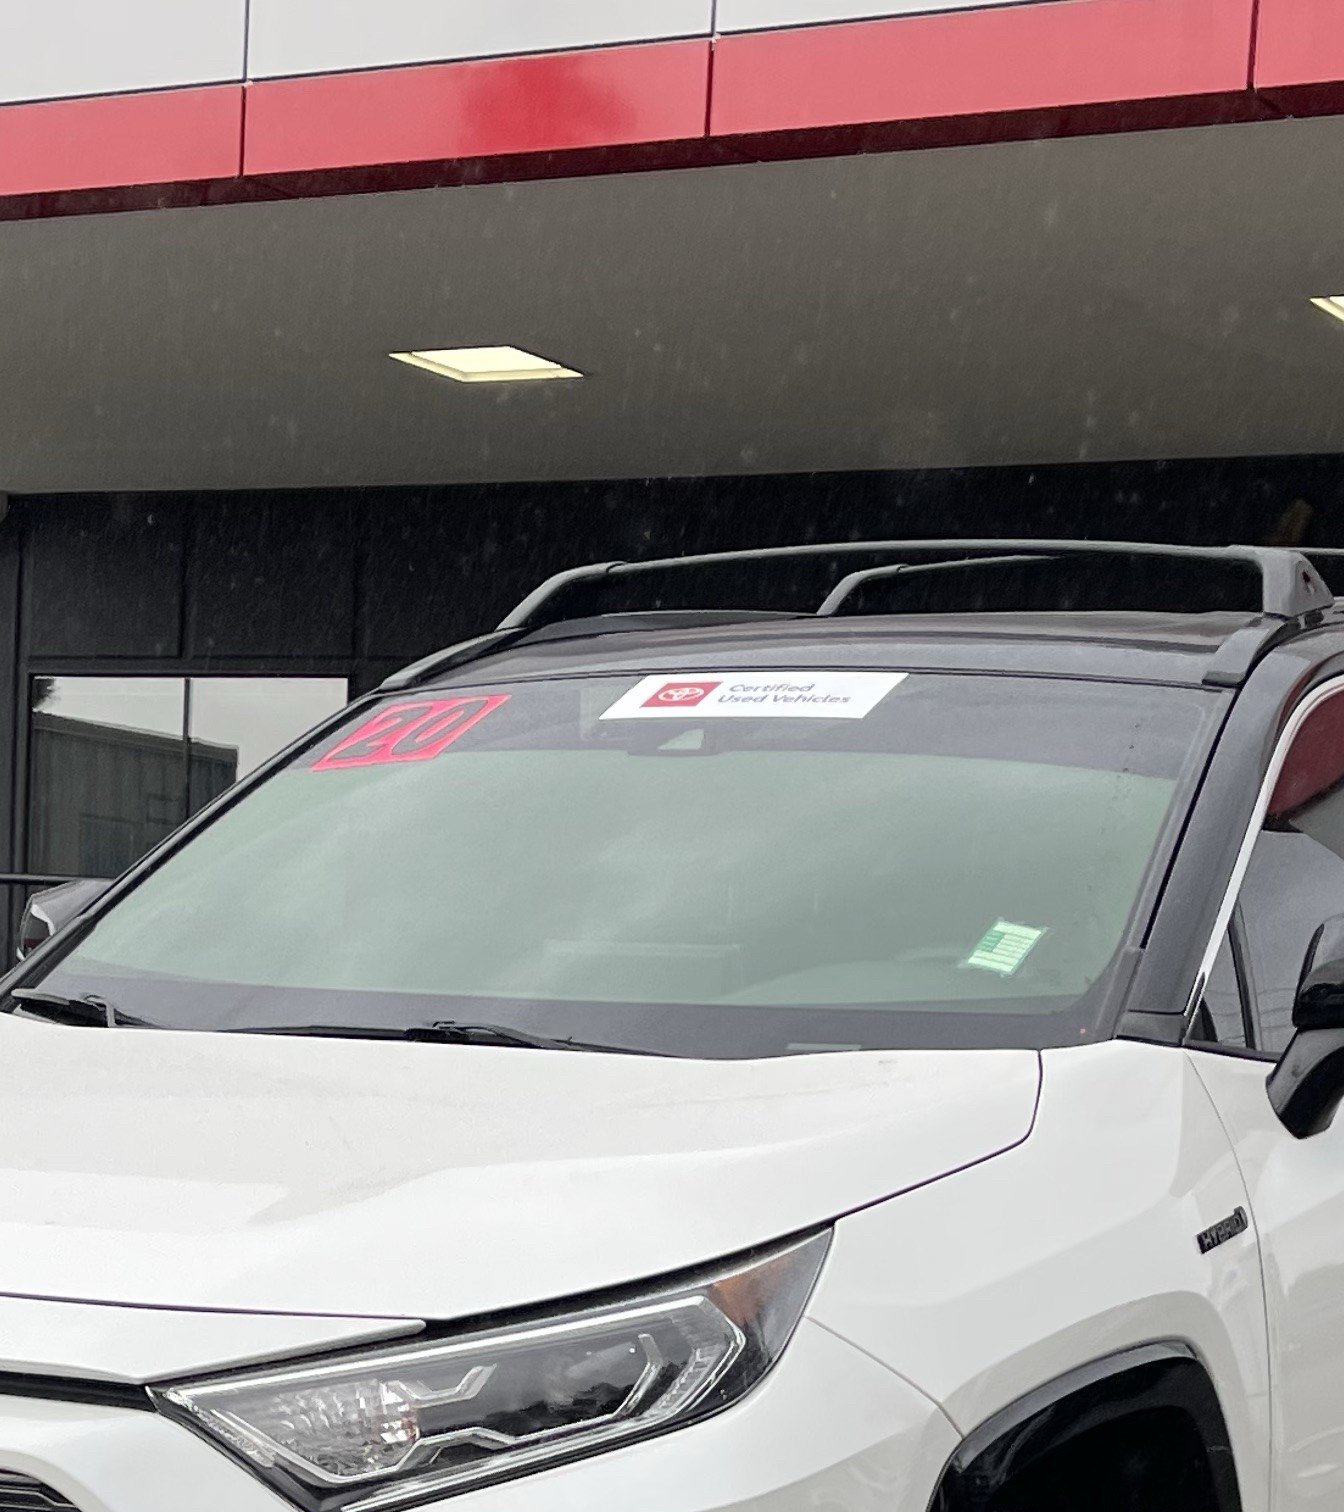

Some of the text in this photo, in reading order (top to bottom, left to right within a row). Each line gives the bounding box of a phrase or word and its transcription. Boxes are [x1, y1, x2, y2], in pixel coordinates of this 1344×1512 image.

[729, 682, 816, 693] Certified
[717, 694, 852, 704] Used Vehicles
[328, 699, 490, 760] 20
